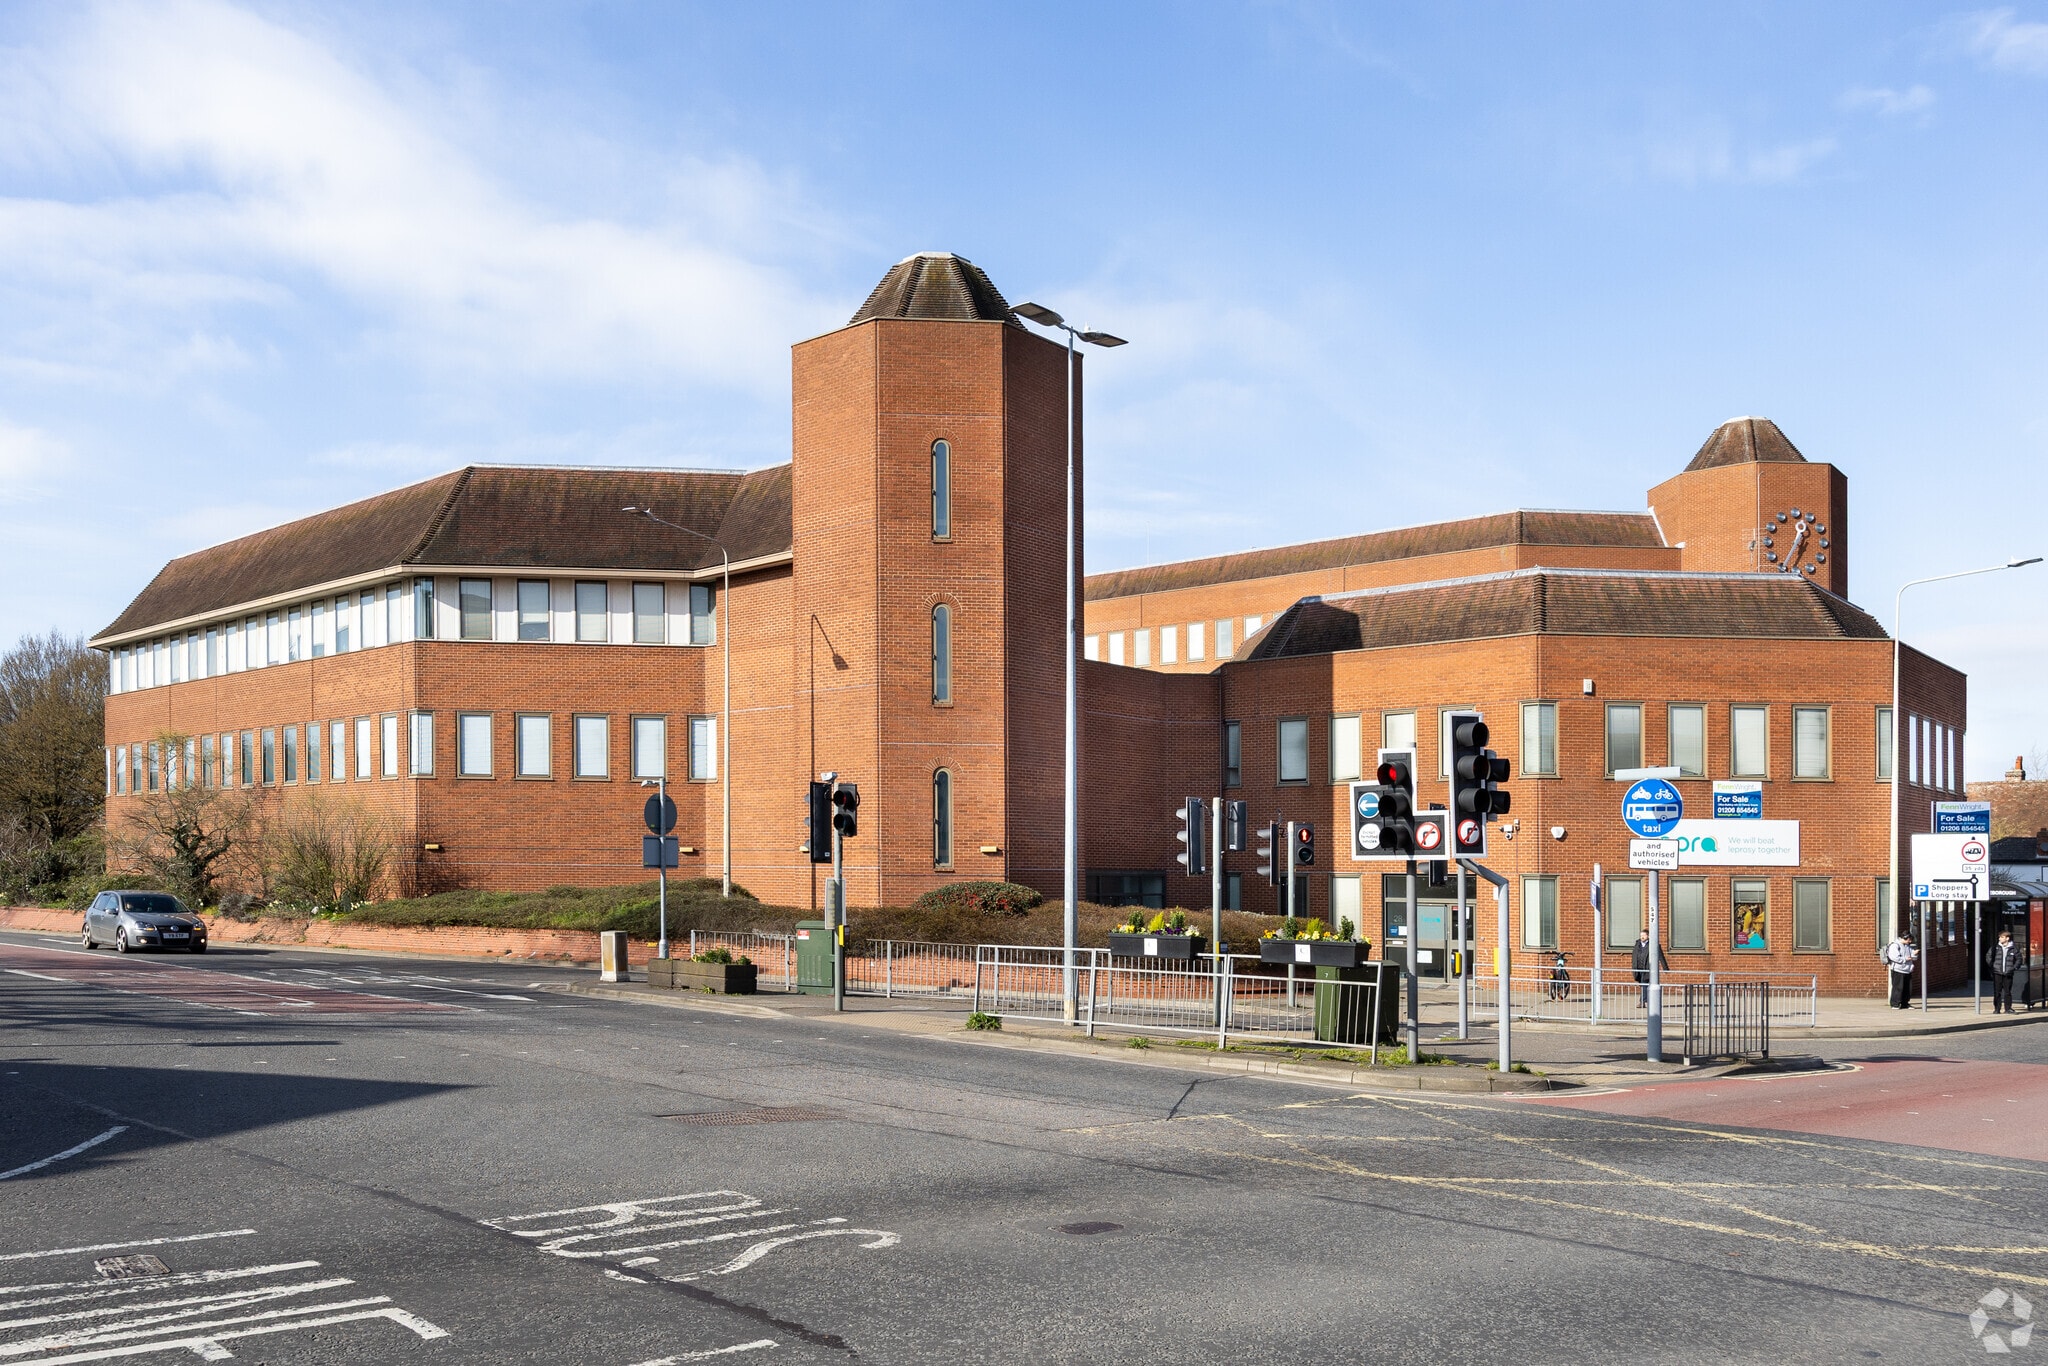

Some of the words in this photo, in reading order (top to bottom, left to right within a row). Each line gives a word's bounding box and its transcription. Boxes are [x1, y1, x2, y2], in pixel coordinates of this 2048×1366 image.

[1717, 795, 1731, 803] For
[1732, 795, 1749, 803] Sale
[1956, 814, 1975, 822] Sale
[1642, 823, 1661, 833] taxi
[1728, 836, 1741, 844] We
[1742, 836, 1756, 844] will
[1757, 836, 1775, 844] beat
[1728, 845, 1757, 854] leprosy
[1758, 845, 1791, 854] together
[1632, 850, 1675, 858] authorised
[1917, 885, 1927, 896] P
